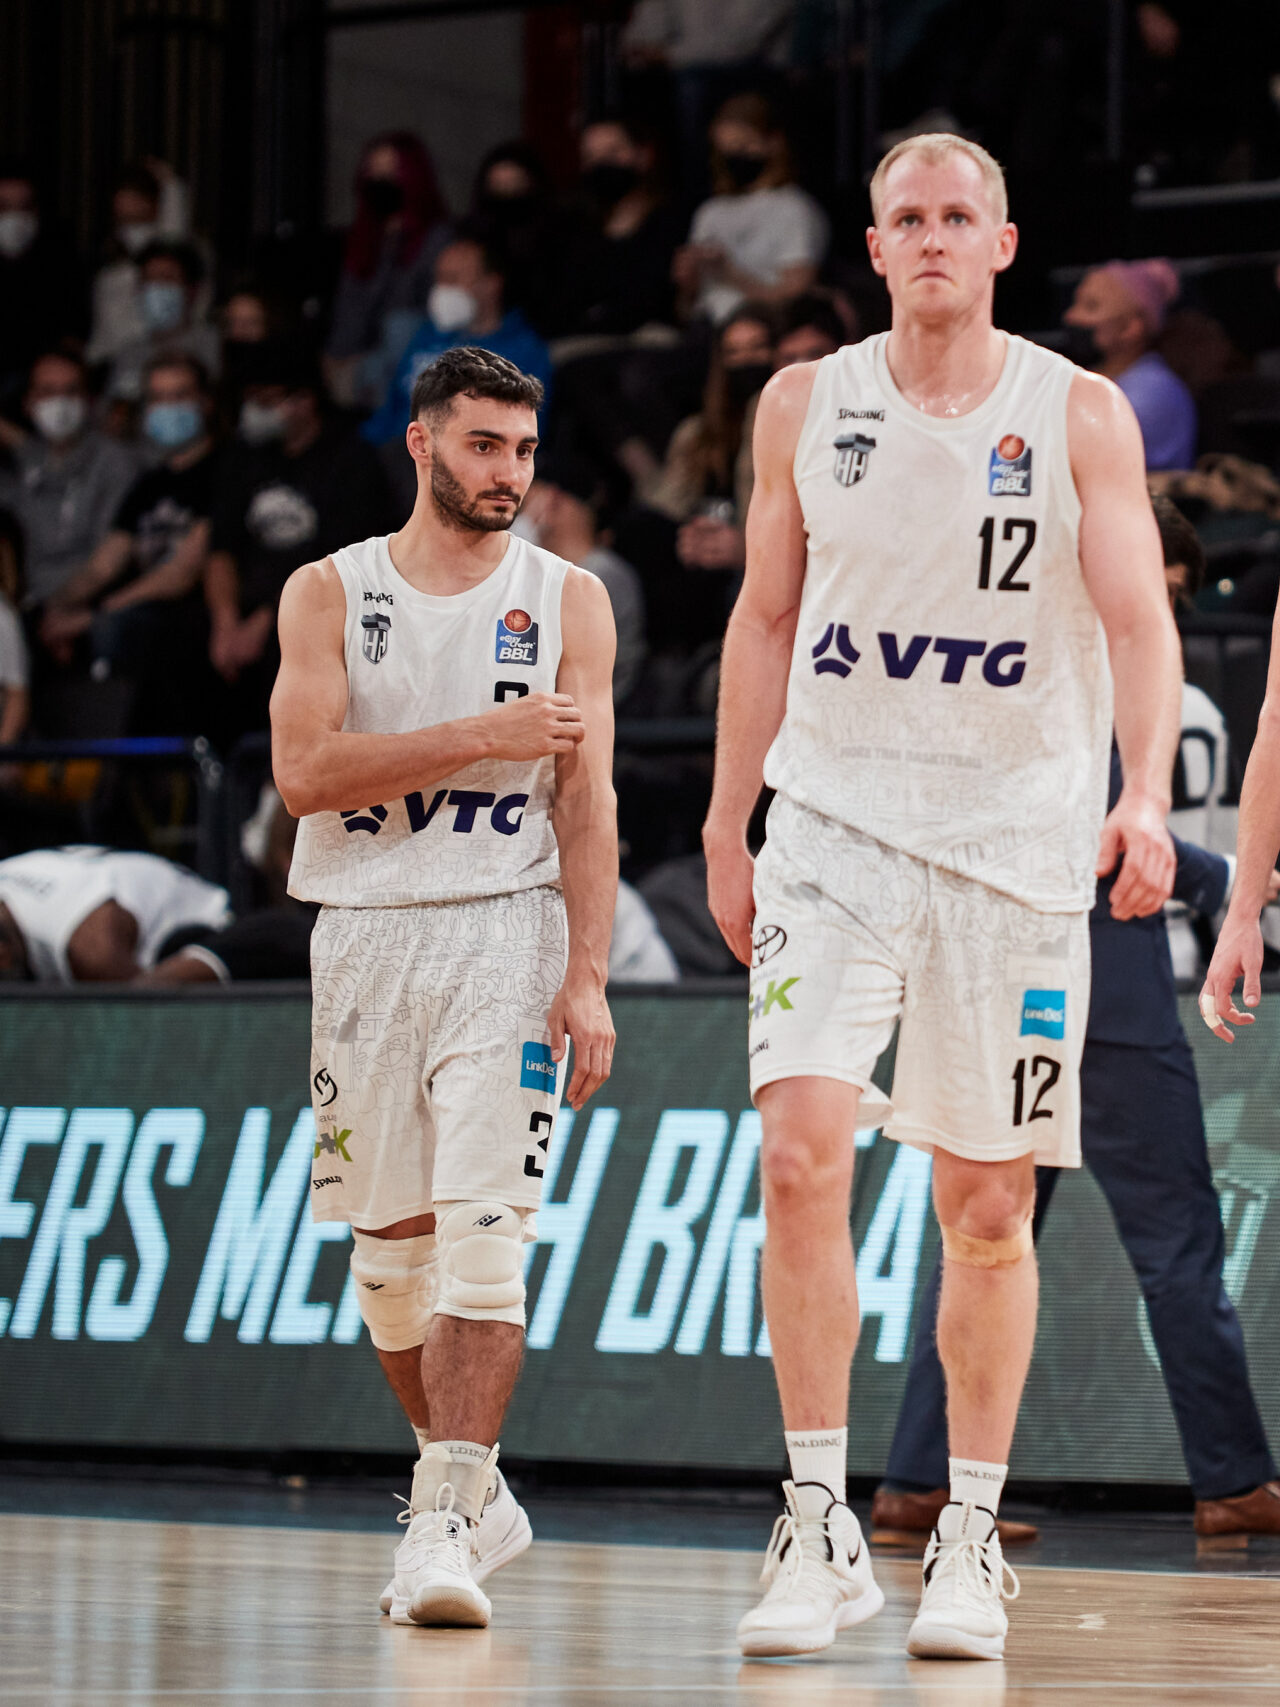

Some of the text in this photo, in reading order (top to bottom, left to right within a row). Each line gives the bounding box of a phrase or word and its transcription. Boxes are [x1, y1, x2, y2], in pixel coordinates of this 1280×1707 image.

[837, 407, 886, 422] SPALDING
[991, 476, 1028, 494] BBL
[978, 516, 1037, 591] 12
[498, 646, 533, 662] BBL
[877, 631, 1027, 687] VTG
[404, 789, 530, 836] VTG
[1012, 1055, 1062, 1127] 12
[524, 1111, 553, 1179] 3
